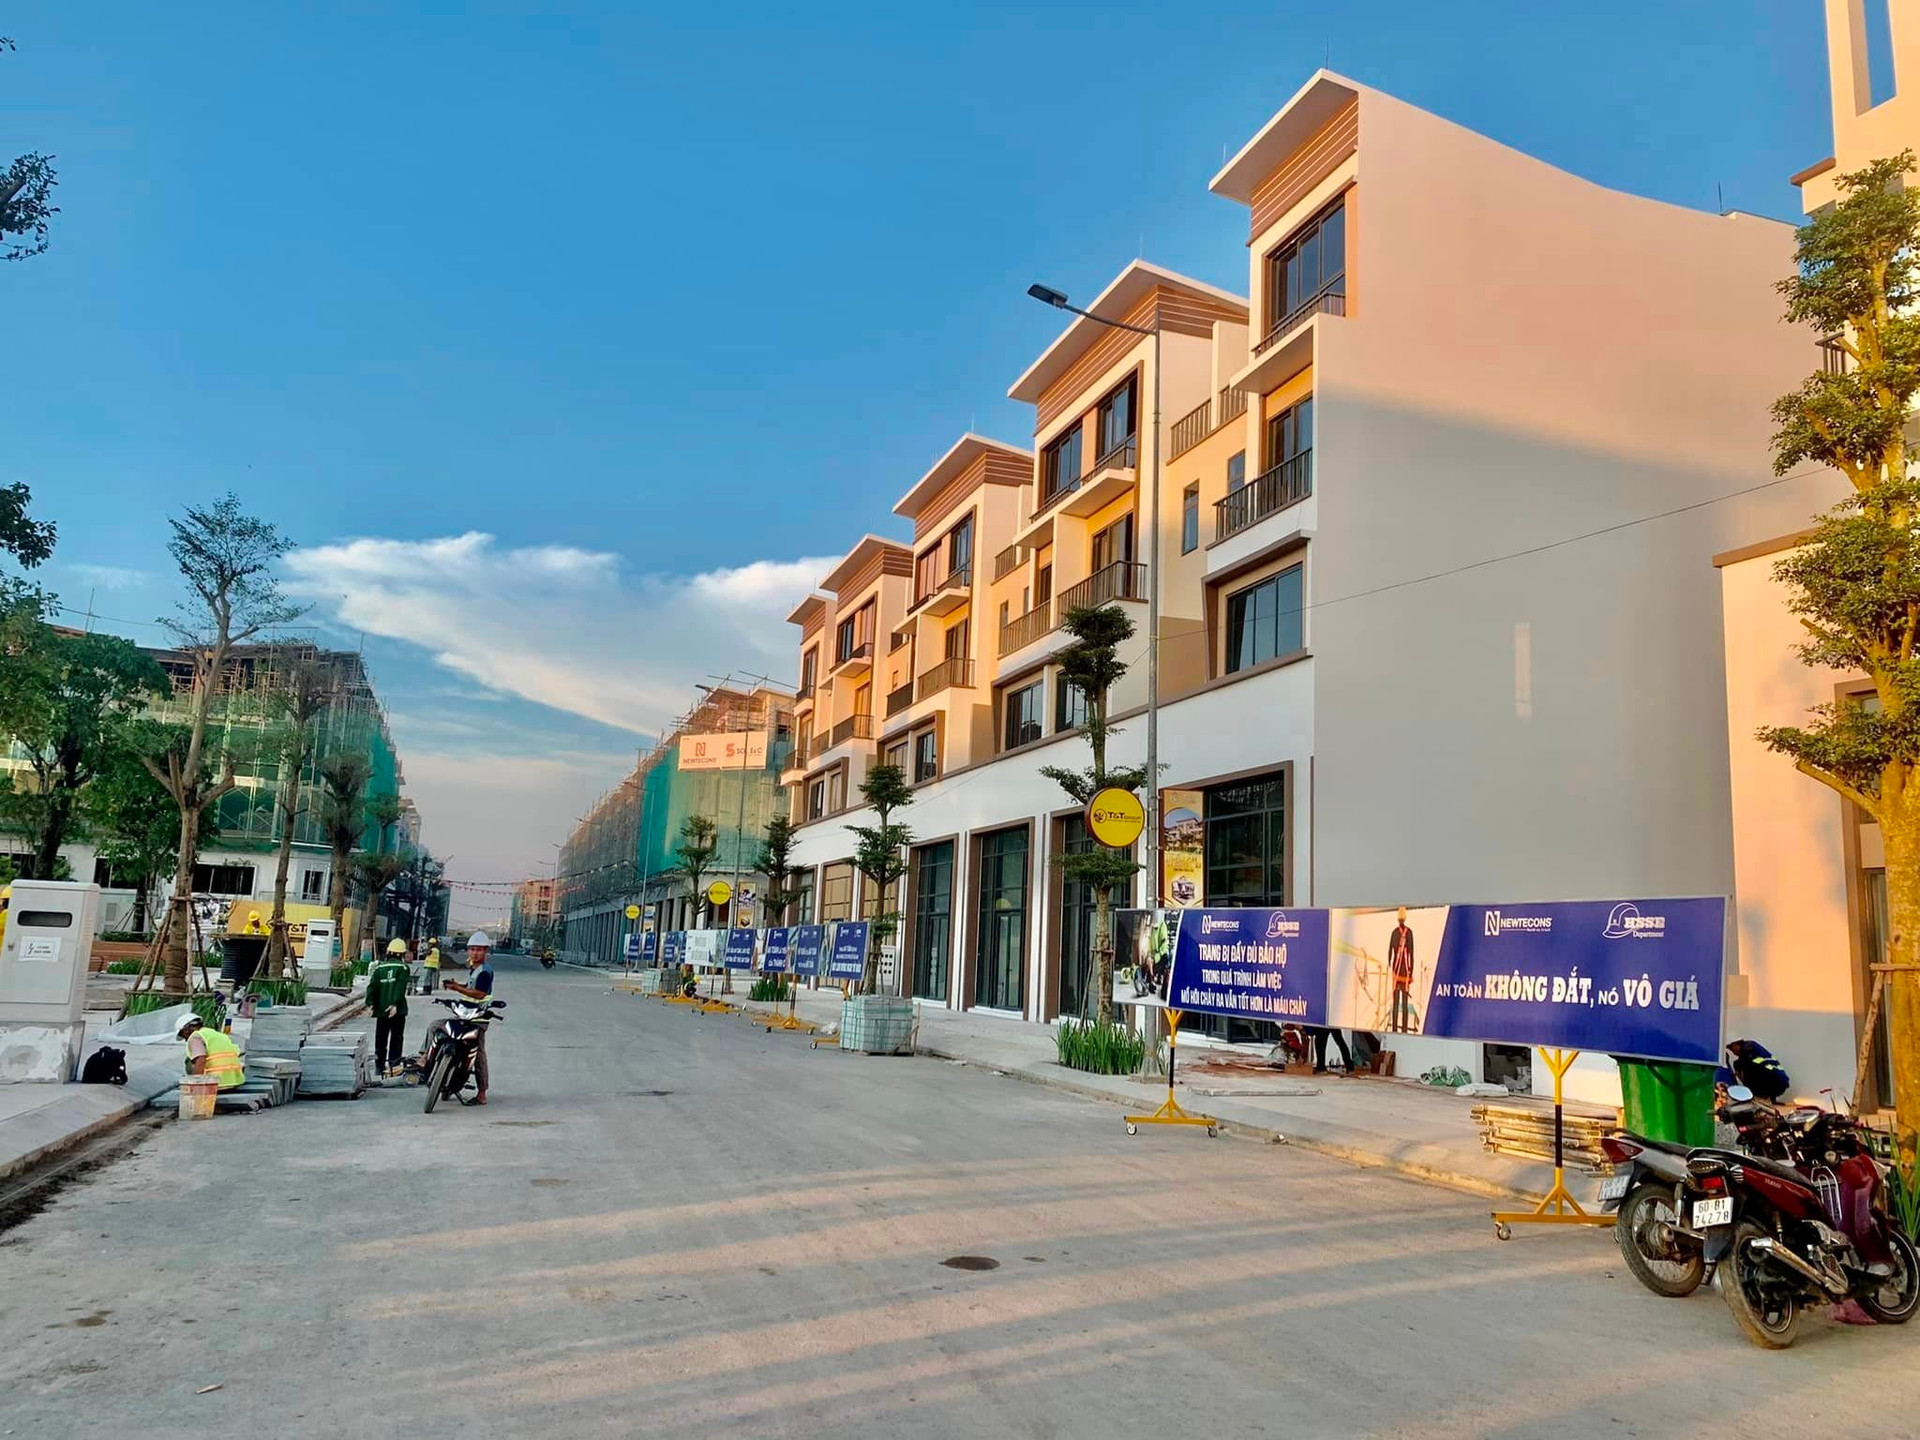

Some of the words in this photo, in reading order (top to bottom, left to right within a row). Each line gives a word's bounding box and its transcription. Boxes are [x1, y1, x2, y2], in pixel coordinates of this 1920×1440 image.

[1500, 917, 1553, 928] NEWTECONS
[1198, 943, 1222, 962] TRANG
[1222, 945, 1230, 966] BỊ
[1258, 940, 1274, 965] BẢO
[1274, 943, 1288, 968] HỘ
[1202, 968, 1221, 985] TRONG
[1220, 968, 1233, 986] QUÁ
[1252, 970, 1267, 989] LÀM
[1267, 971, 1282, 992] VIỆC
[1436, 983, 1451, 997] AN
[1453, 981, 1482, 999] TOÀN
[1484, 969, 1548, 1002] KHÔNG
[1598, 987, 1619, 1006] NÓ
[1623, 973, 1653, 1008] VÔ
[1658, 975, 1700, 1010] GIÁ
[1215, 992, 1225, 1008] RA
[1238, 991, 1249, 1010] TỐT
[1264, 995, 1273, 1013] LÀ
[1273, 995, 1289, 1015] MÁU
